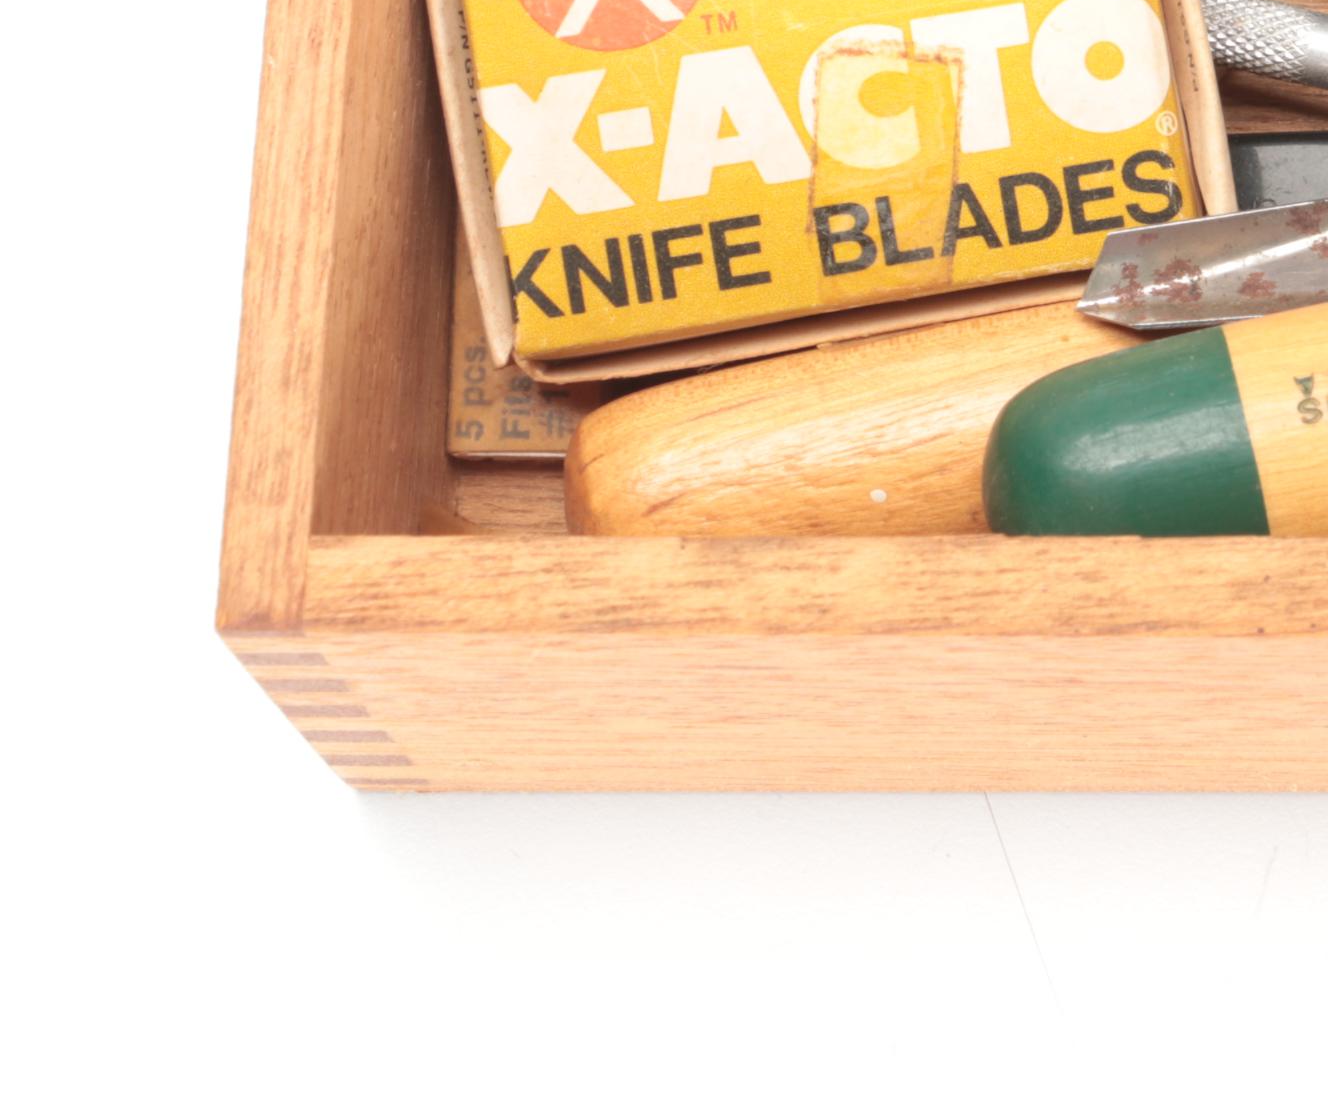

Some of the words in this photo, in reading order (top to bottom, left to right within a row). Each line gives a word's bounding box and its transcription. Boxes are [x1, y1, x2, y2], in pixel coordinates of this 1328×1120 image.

[700, 10, 739, 35] TM
[504, 214, 773, 324] KNIFE
[814, 149, 1185, 276] BLADES
[463, 335, 492, 407] pcs.
[455, 417, 485, 441] 5
